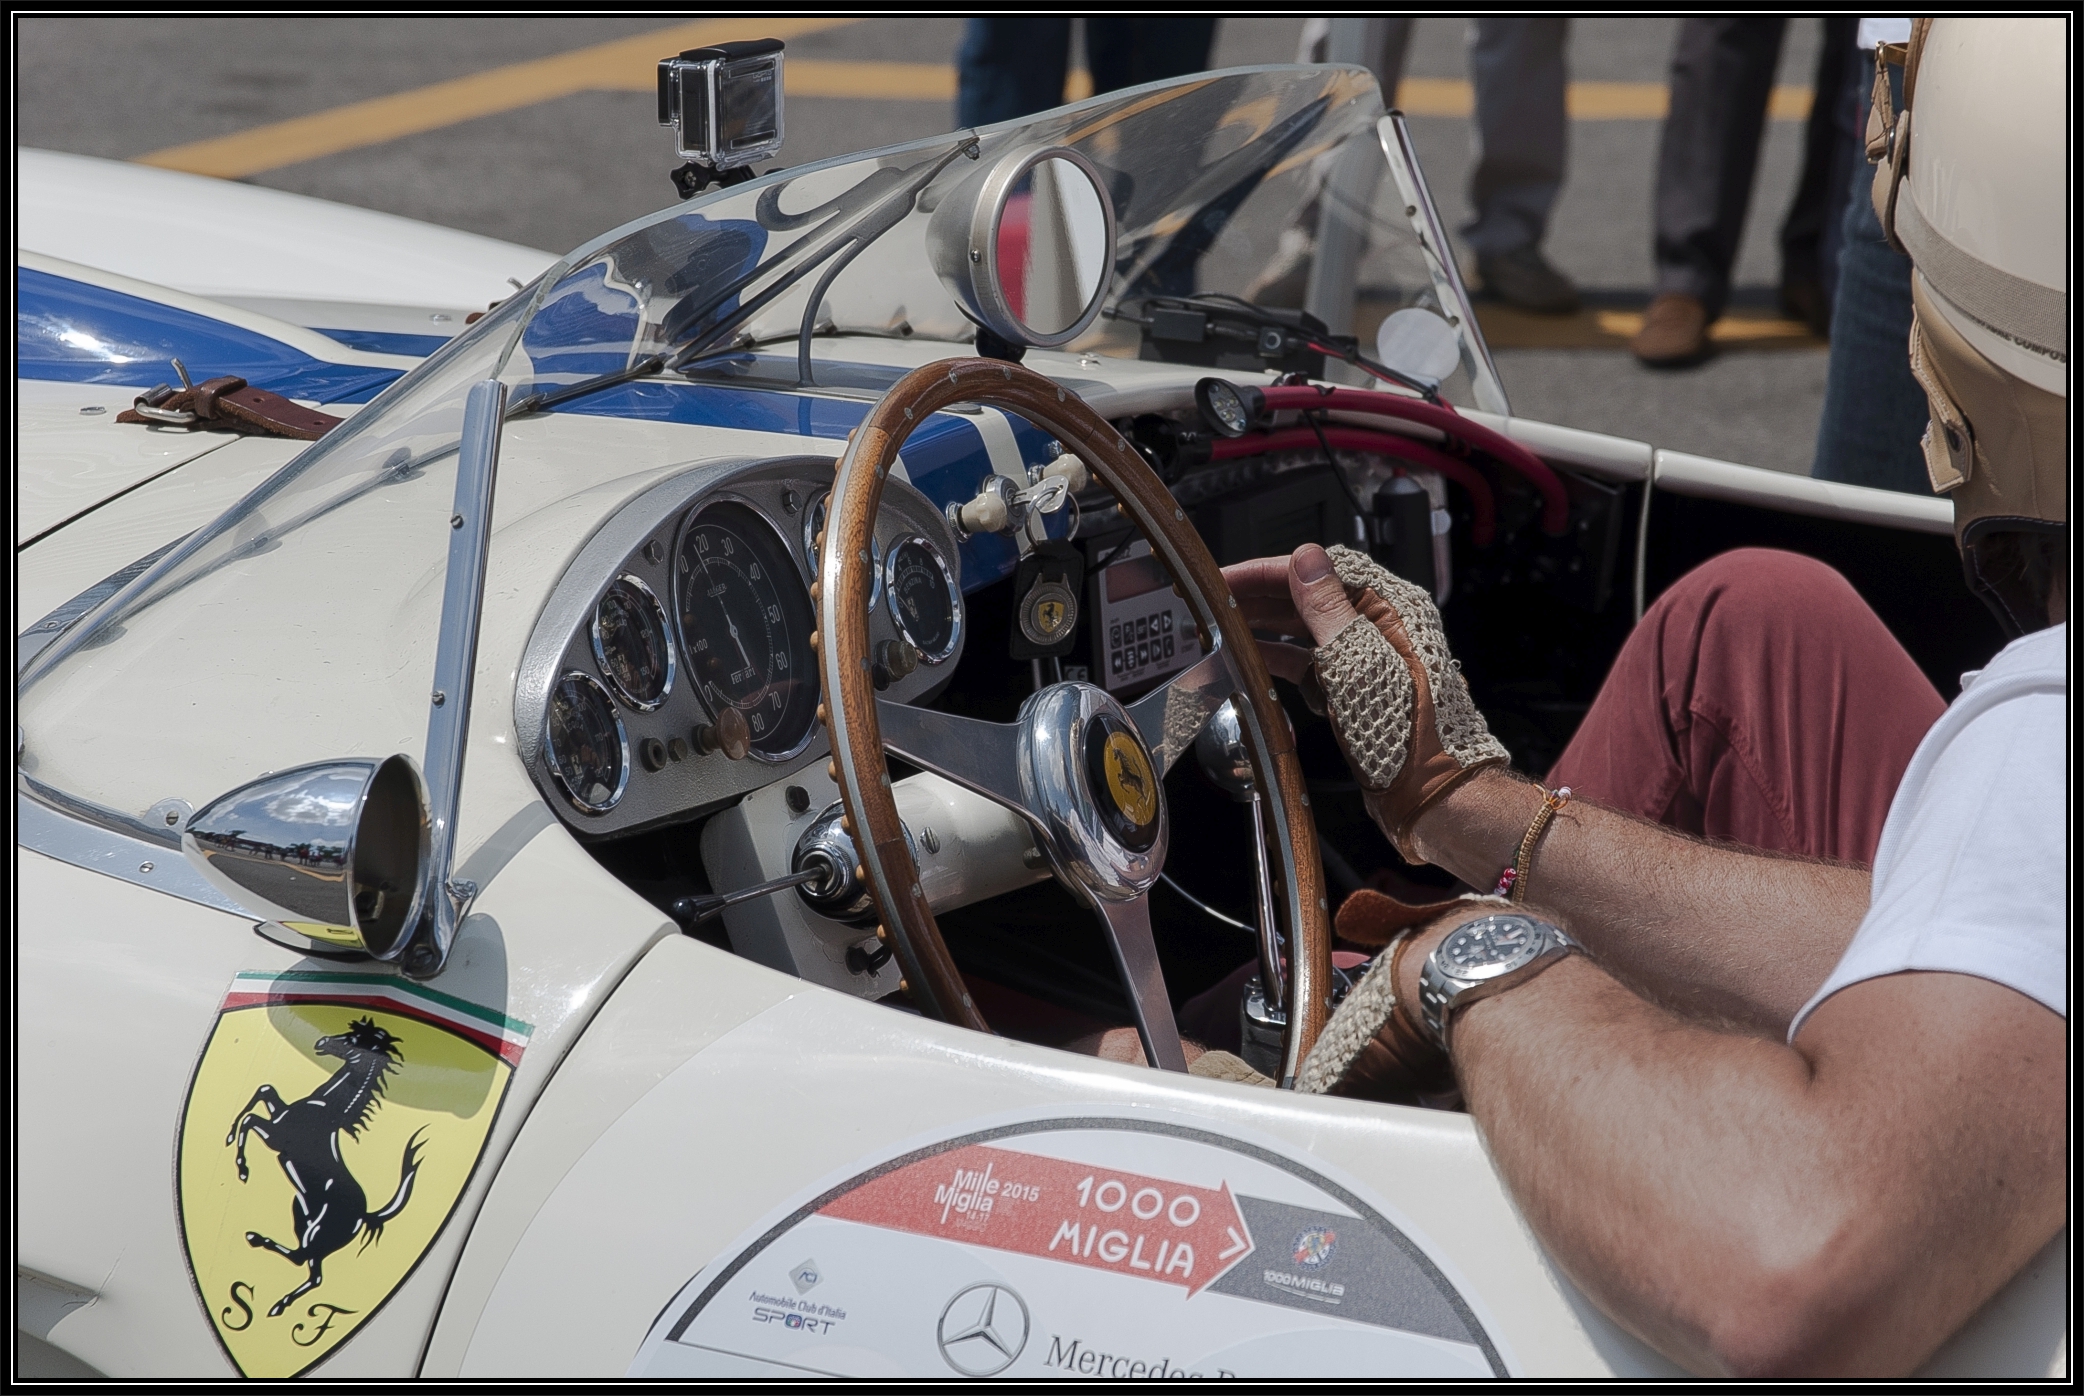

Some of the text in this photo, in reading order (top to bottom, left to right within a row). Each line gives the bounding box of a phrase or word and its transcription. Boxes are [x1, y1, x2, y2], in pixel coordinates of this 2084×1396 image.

[695, 533, 710, 554] 20
[720, 536, 734, 556] 30
[679, 554, 689, 574] 10
[749, 562, 761, 581] 40
[767, 604, 781, 624] 50
[775, 651, 788, 671] 60
[768, 690, 782, 711] 70
[751, 712, 765, 733] 80
[952, 1162, 1000, 1195] Mille
[1001, 1181, 1040, 1202] 2015
[1076, 1176, 1201, 1228] 1000
[933, 1184, 994, 1225] Miglia
[1049, 1219, 1195, 1278] MIGLIA
[798, 1271, 818, 1284] ACI
[749, 1290, 797, 1311] Automobile
[797, 1299, 817, 1314] Club
[220, 1281, 360, 1347] S F
[752, 1306, 836, 1335] SPORT
